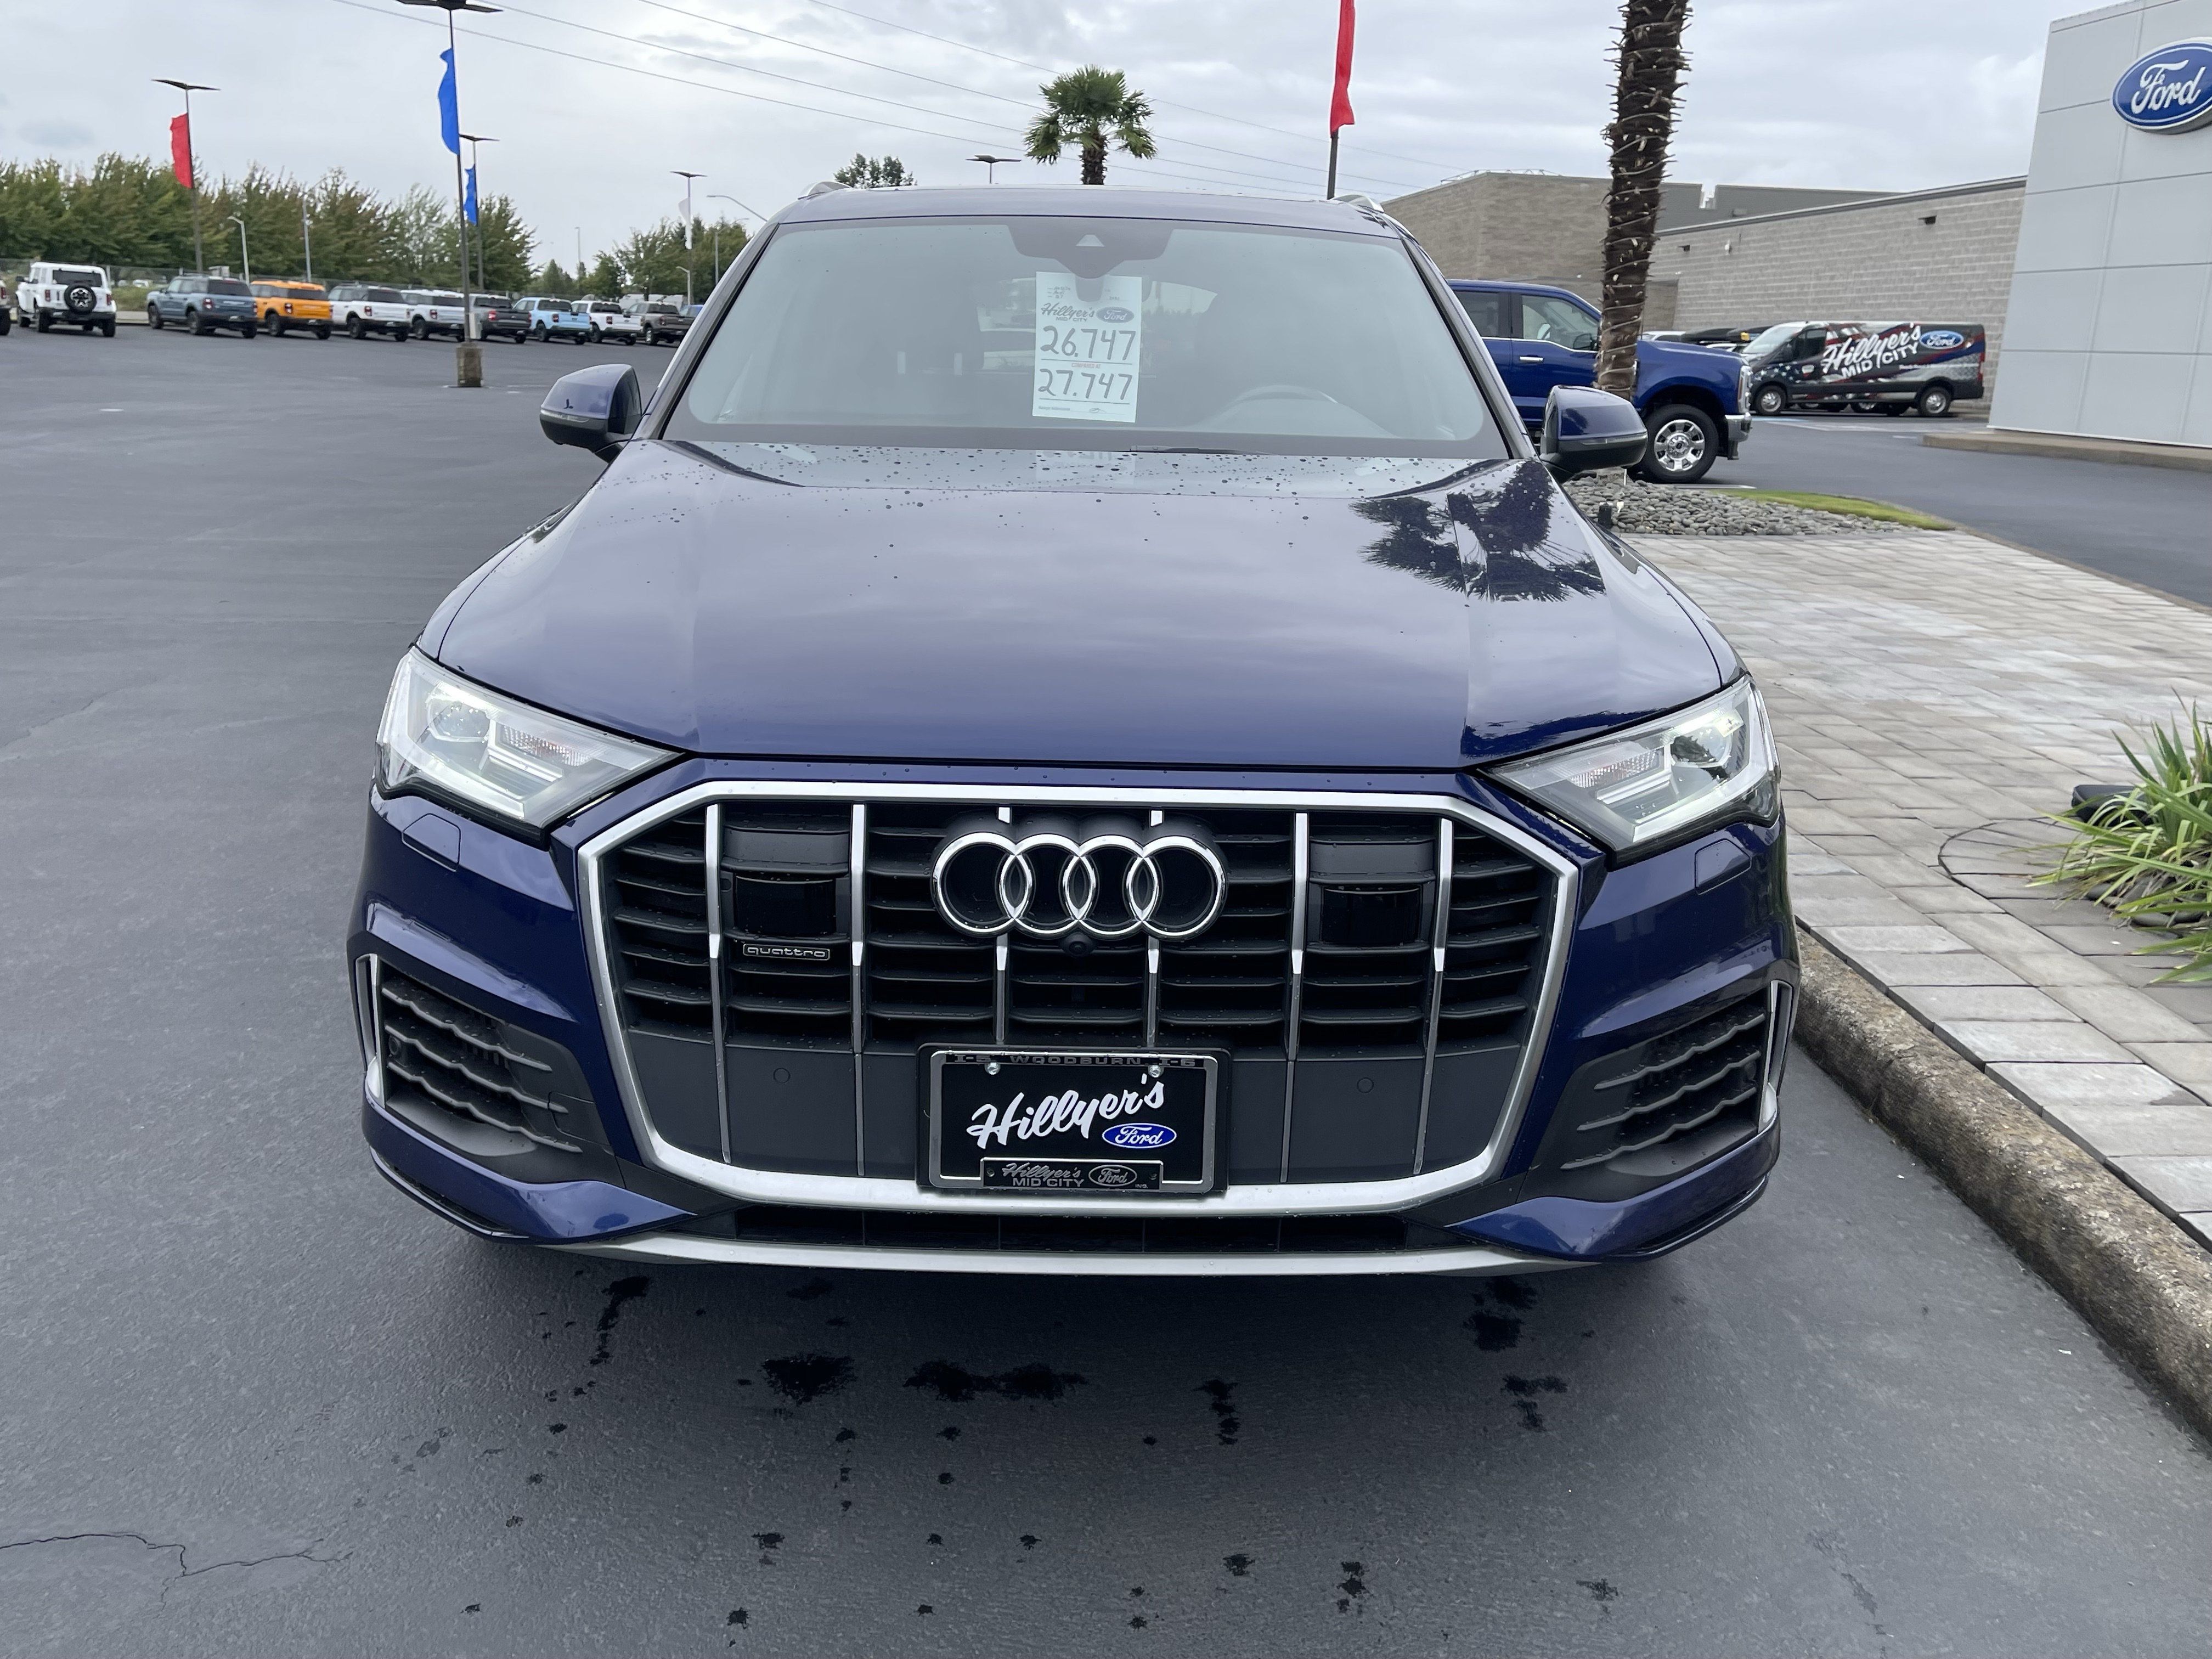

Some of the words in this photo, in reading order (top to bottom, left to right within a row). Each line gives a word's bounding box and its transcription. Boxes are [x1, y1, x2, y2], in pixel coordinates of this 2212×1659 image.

[2131, 59, 2206, 114] Ford
[1041, 302, 1095, 320] Hillyer's
[1103, 309, 1127, 321] Ford
[1820, 322, 1921, 374] Hillyer's
[1926, 334, 1956, 347] Ford
[1841, 360, 1874, 379] MID
[1882, 342, 1919, 365] CITY
[747, 947, 826, 957] quattro
[1010, 1055, 1142, 1065] WOODBURN
[967, 1073, 1164, 1149] Hillyer's
[1115, 1125, 1163, 1146] Ford
[1002, 1163, 1081, 1182] Hillyer's
[1098, 1168, 1128, 1184] Ford
[1013, 1178, 1041, 1187] MID
[1046, 1178, 1084, 1187] CITY
